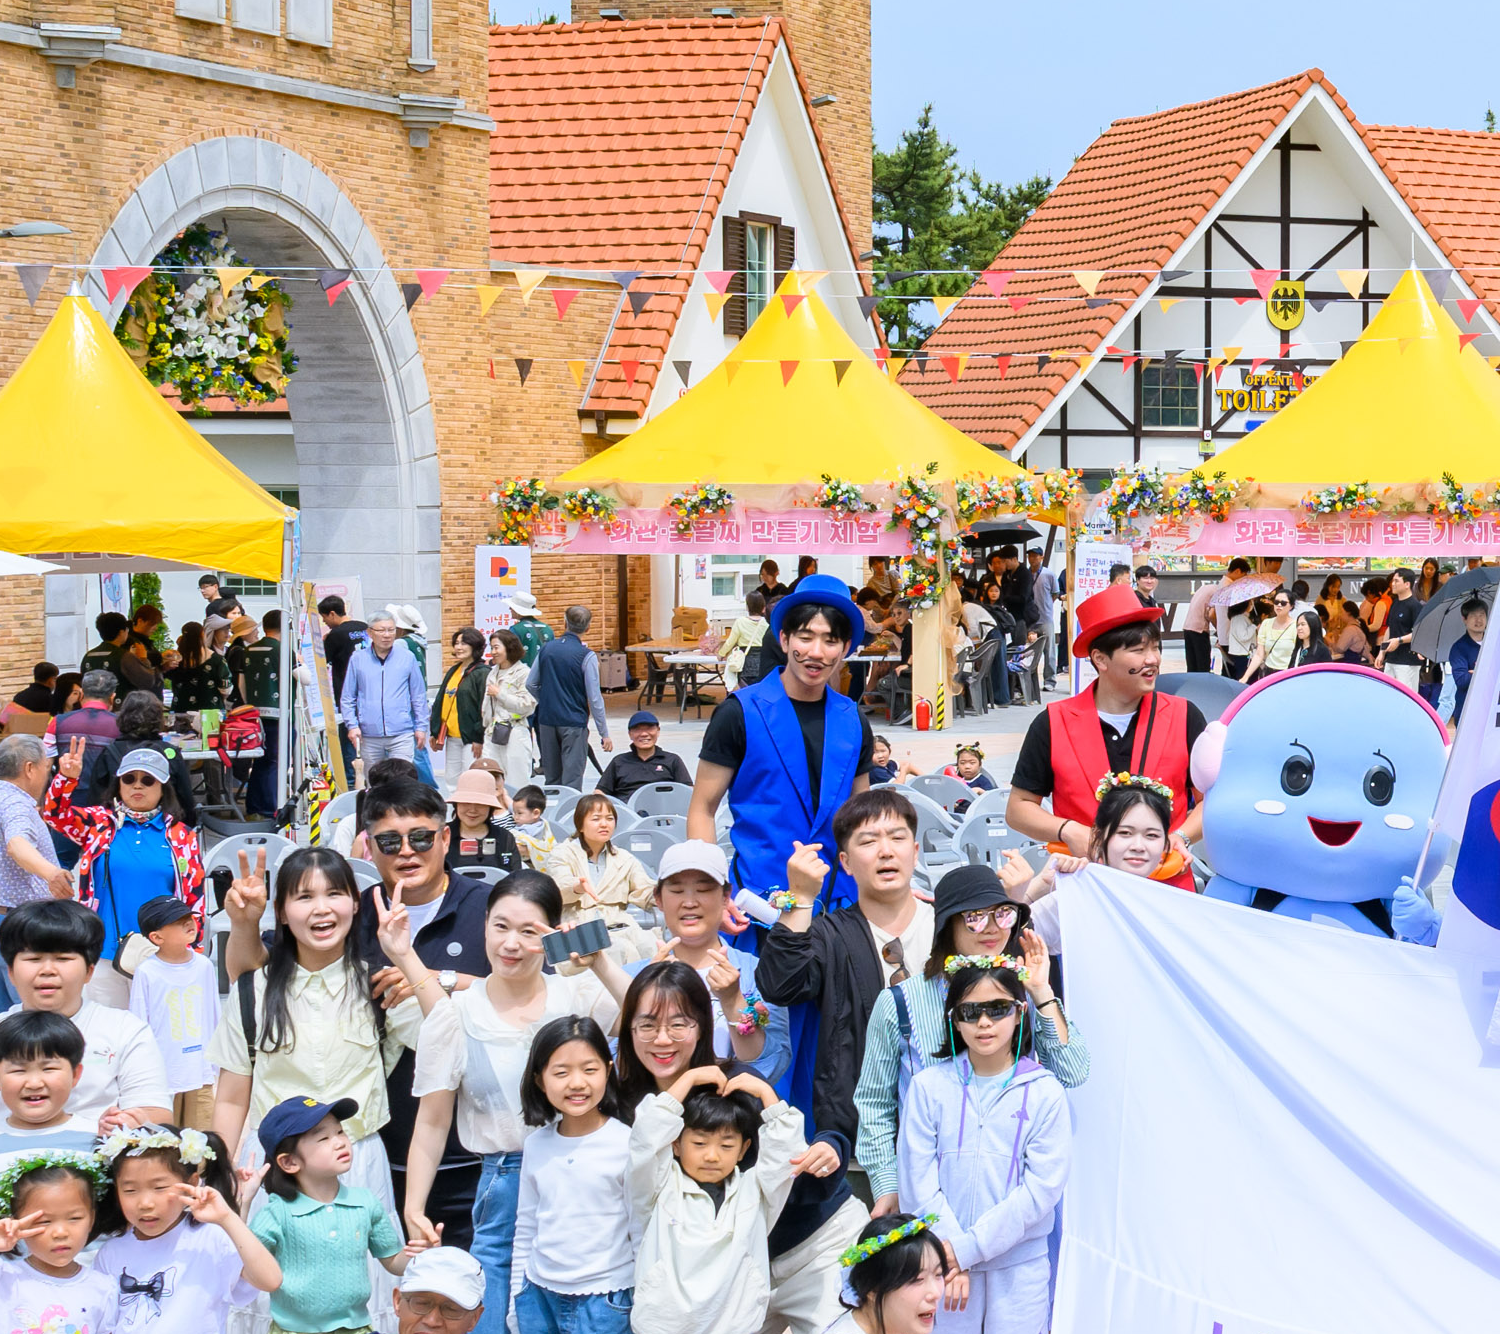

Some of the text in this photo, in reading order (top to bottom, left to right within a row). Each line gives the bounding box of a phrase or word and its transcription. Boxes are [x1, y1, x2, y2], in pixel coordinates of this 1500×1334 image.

[1216, 389, 1300, 412] TOILE
[751, 520, 821, 544] 만들기
[828, 520, 881, 545] 체험
[1382, 520, 1454, 545] 만들기
